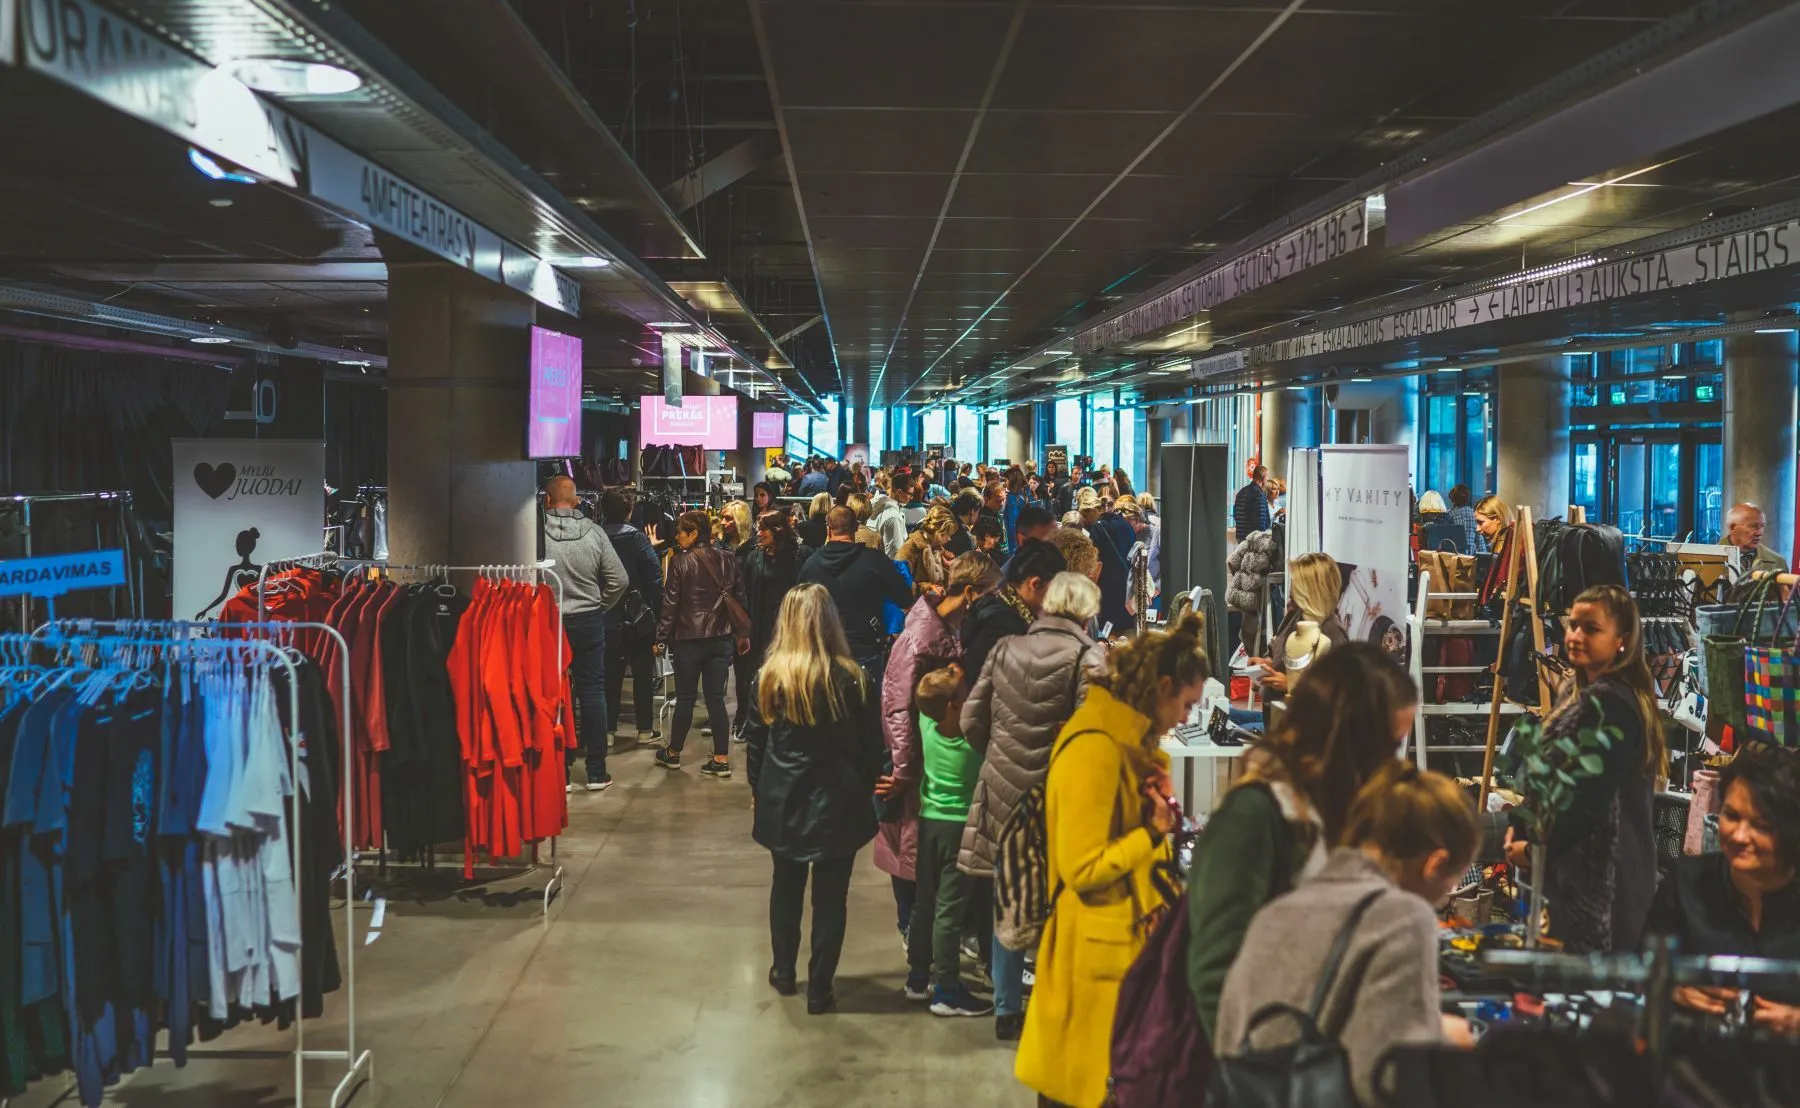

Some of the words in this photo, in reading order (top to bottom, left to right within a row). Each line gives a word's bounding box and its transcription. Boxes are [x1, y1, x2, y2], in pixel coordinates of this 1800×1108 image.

[361, 164, 463, 258] AMFITEATRAS
[1233, 243, 1281, 297] SECTORS
[1299, 211, 1346, 271] 121-136
[1322, 318, 1384, 353] ESKALATORIUS
[1393, 302, 1457, 339] ESCALATOR
[1502, 278, 1560, 318] LAIPTAI
[1695, 225, 1789, 282] STAIRS
[227, 478, 302, 500] JUODAI
[1347, 487, 1402, 507] VANITY
